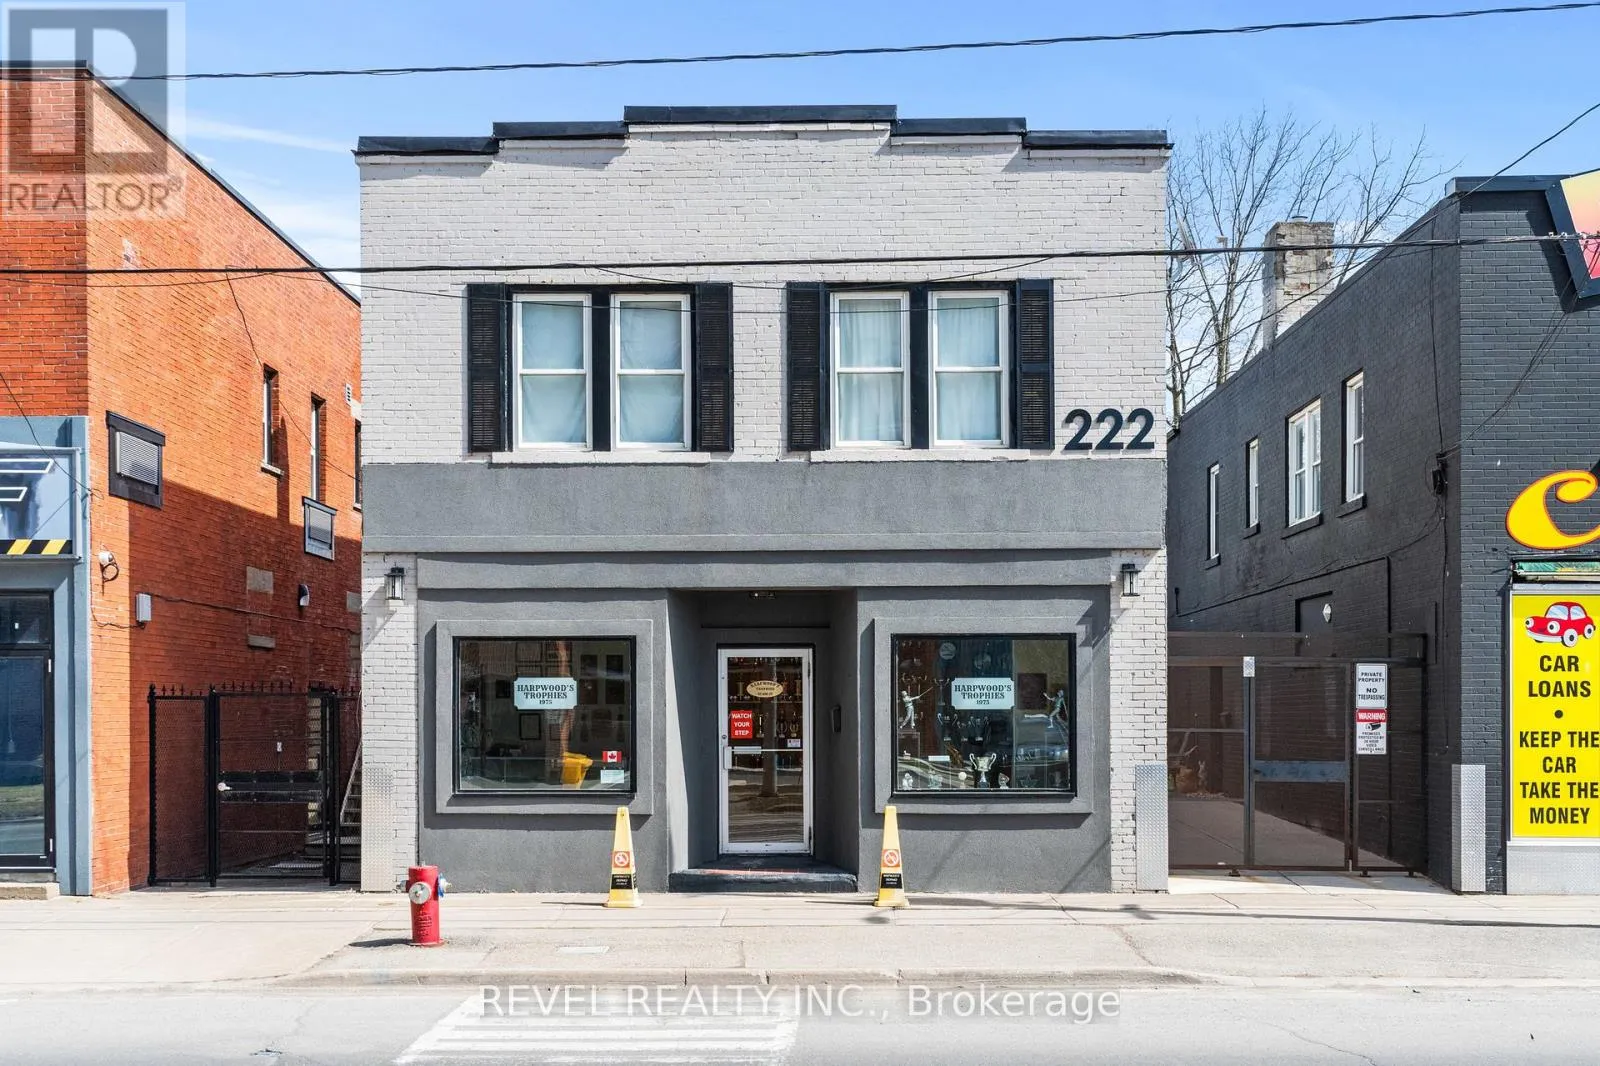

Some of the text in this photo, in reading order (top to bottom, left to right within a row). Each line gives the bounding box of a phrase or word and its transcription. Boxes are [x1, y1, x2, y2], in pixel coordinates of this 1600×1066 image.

[1064, 408, 1155, 450] 222
[1539, 655, 1580, 672] CAR
[517, 684, 575, 692] HARPWOOD'S
[523, 691, 568, 700] TROPHIES
[954, 684, 1012, 692] HARPWOOD'S
[961, 691, 1005, 700] TROPHIES
[1528, 680, 1591, 697] LOANS
[1358, 712, 1386, 720] WARNING
[1519, 731, 1600, 748] KEEP THE
[1542, 756, 1577, 773] CAR
[1519, 781, 1600, 799] TAKE THE
[1529, 807, 1591, 825] MONEY
